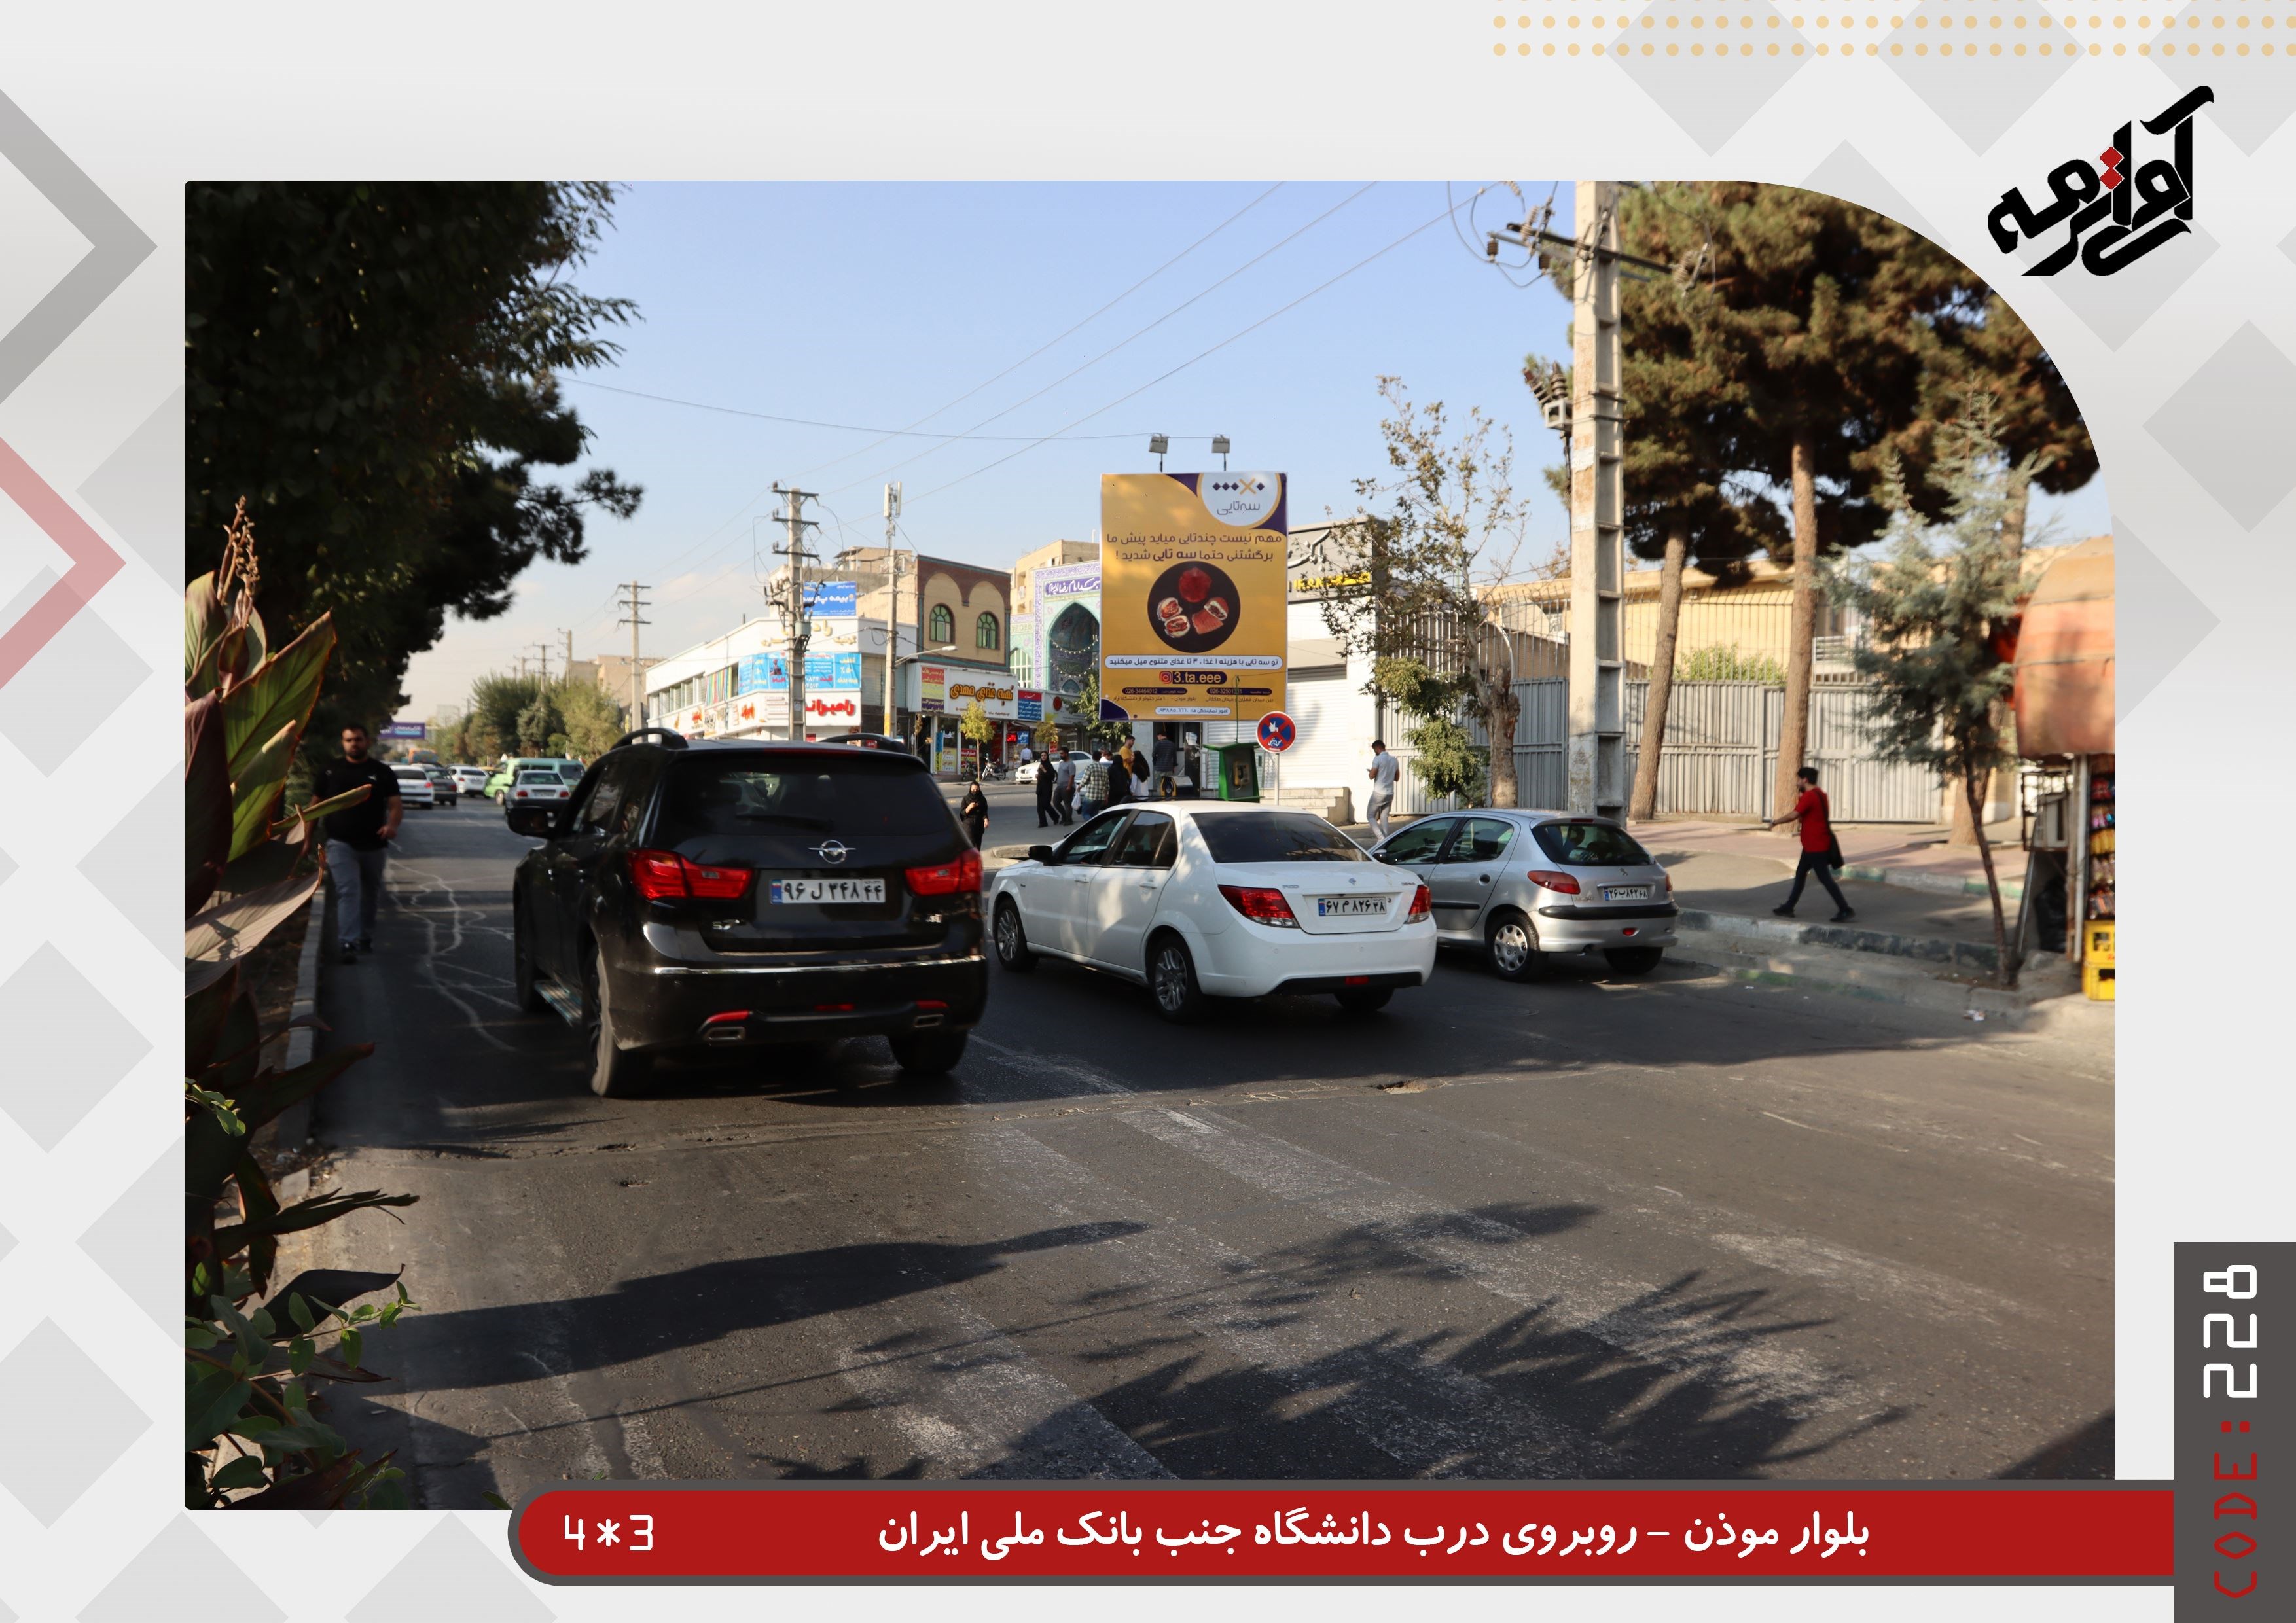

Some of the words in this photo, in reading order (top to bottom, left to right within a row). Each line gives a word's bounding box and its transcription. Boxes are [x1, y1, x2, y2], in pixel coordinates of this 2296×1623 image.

[1107, 533, 1118, 543] ما
[1121, 532, 1146, 546] پیش
[1149, 533, 1175, 544] میاید
[1219, 533, 1251, 544] نیست
[1255, 534, 1282, 544] مهم
[1122, 548, 1151, 561] شدید
[1153, 548, 1173, 561] تایی
[1177, 550, 1196, 559] سه
[1199, 550, 1223, 560] حتما
[1227, 548, 1273, 562] برگشتنی
[829, 595, 849, 603] بیمه
[1174, 671, 1222, 683] 3.ta.eee
[784, 882, 806, 900] ۹۶
[811, 882, 823, 900] ل
[864, 885, 882, 901] ۴۴
[1326, 900, 1339, 913] ۶۷
[1342, 900, 1350, 912] م
